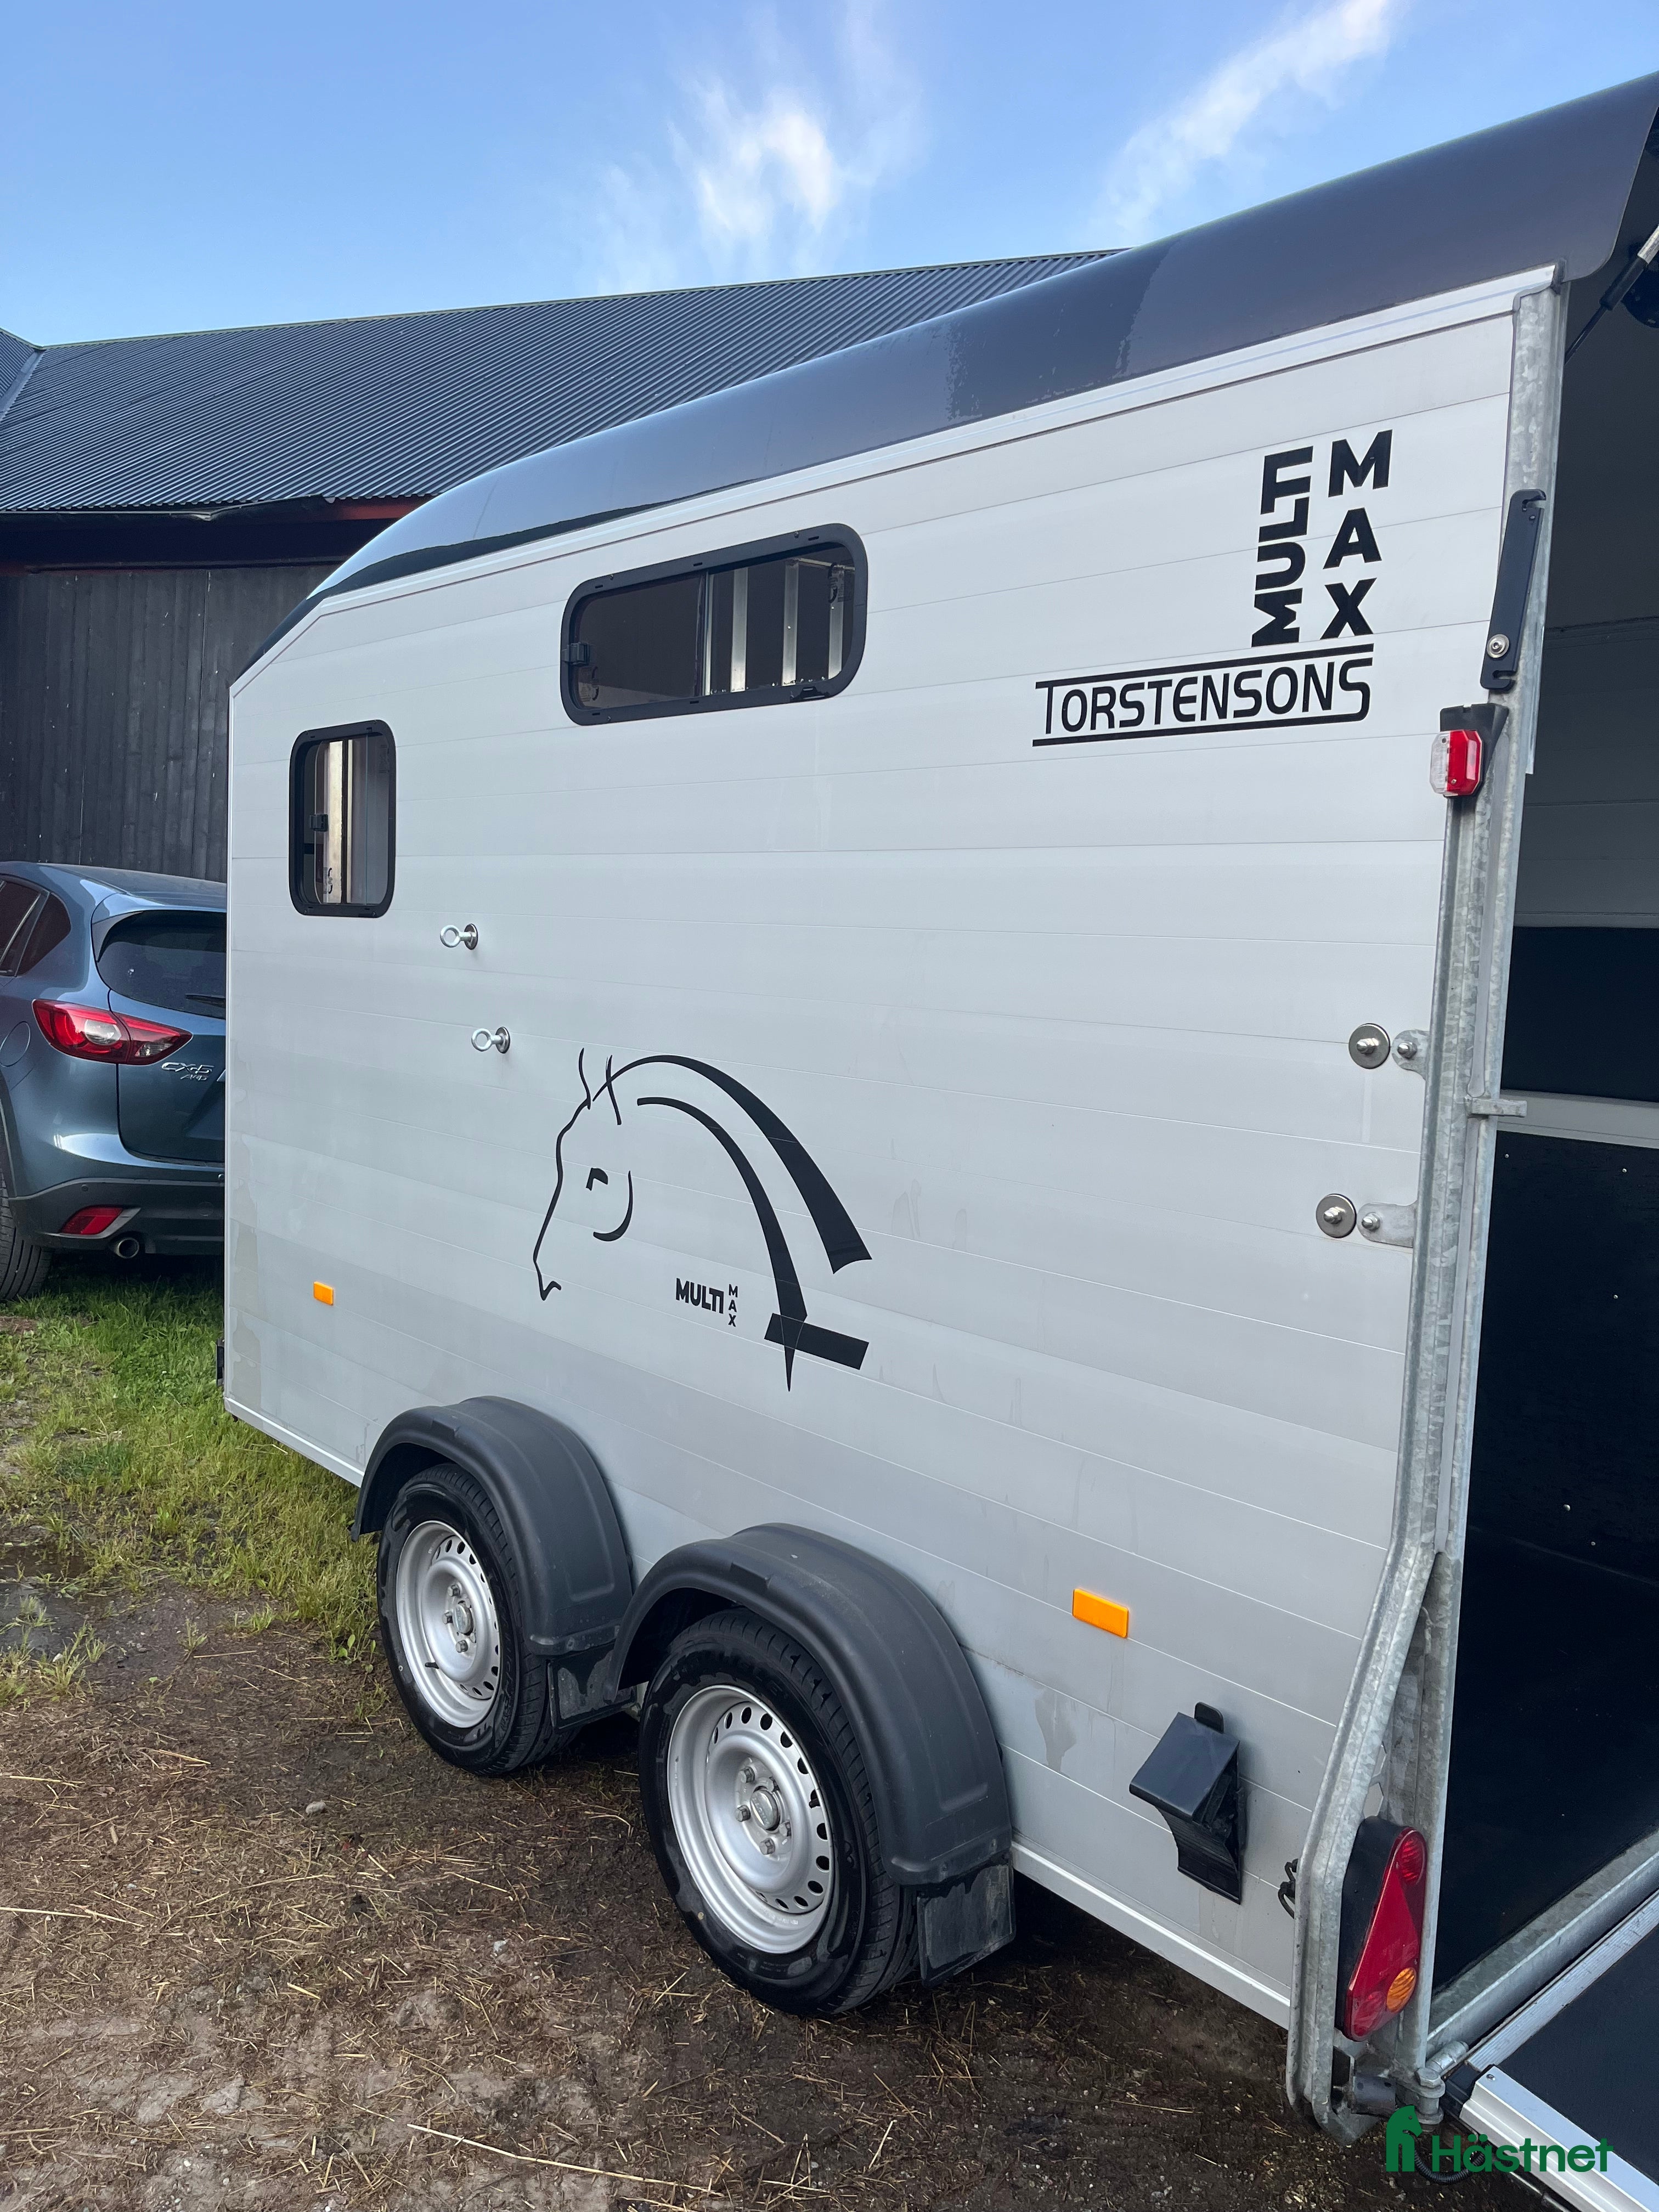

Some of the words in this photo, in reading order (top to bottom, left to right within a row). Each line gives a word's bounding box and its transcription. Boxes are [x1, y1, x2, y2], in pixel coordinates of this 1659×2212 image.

[1251, 445, 1314, 648] MULTI
[1319, 429, 1393, 640] MAX
[1034, 650, 1374, 742] TORSTENSONS
[161, 1062, 215, 1074] CX-5
[675, 1278, 724, 1314] MULTI
[728, 1284, 738, 1327] MAX
